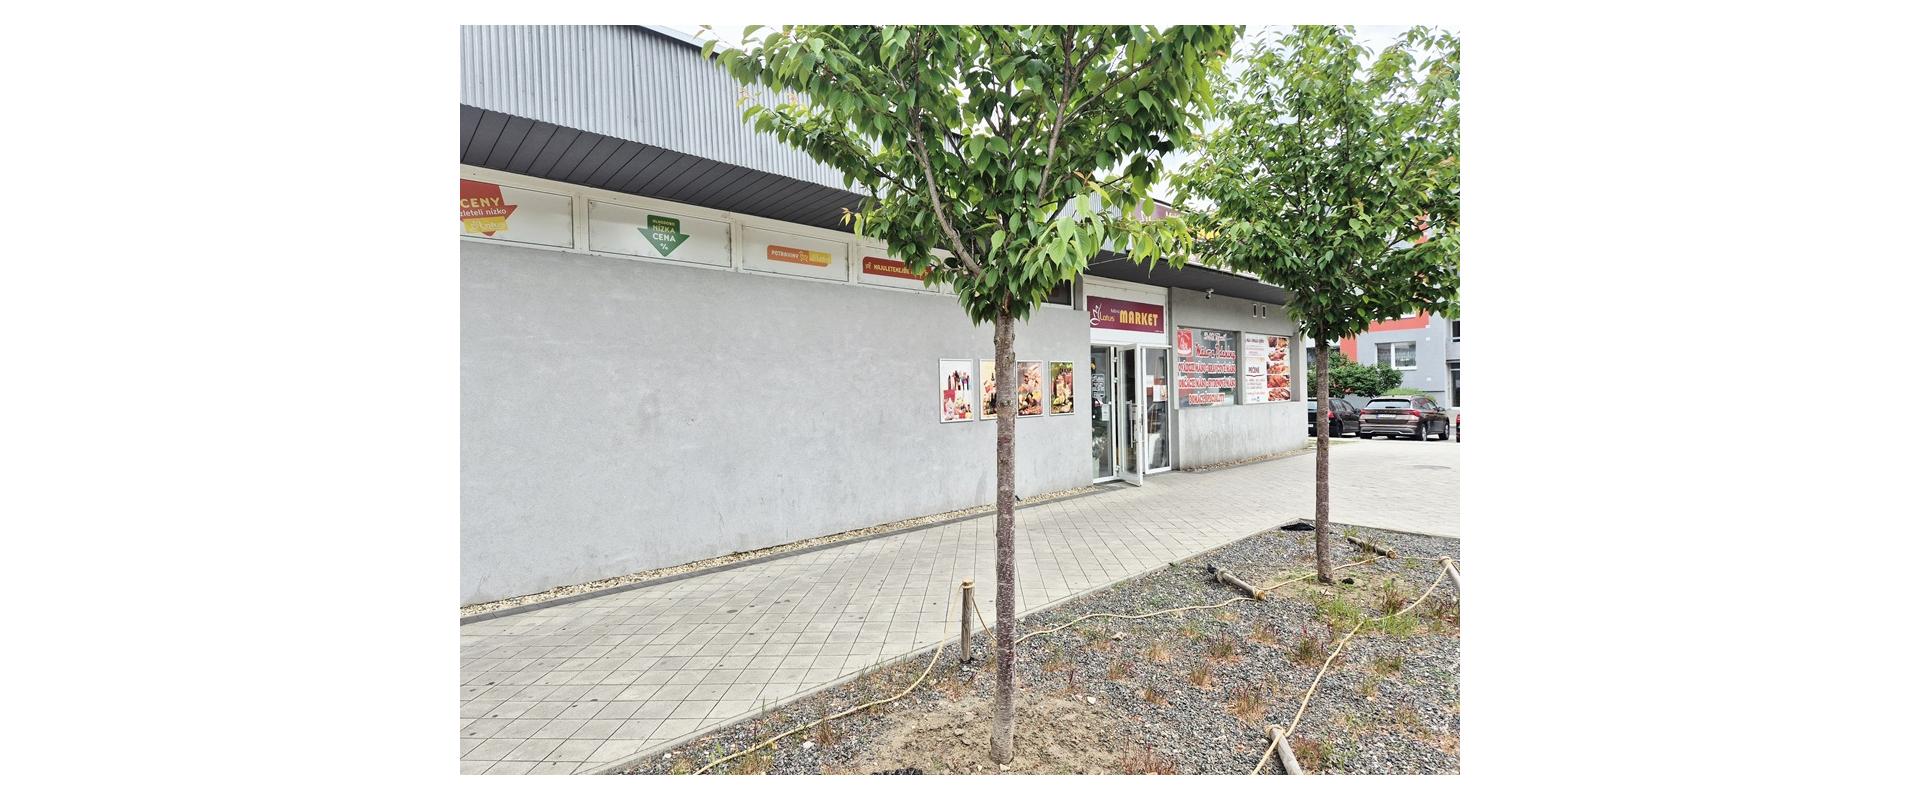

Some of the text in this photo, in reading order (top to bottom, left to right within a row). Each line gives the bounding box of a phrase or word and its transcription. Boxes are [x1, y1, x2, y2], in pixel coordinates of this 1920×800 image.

[460, 197, 500, 208] CENY
[652, 232, 676, 242] CENA
[1119, 309, 1158, 327] MARKET
